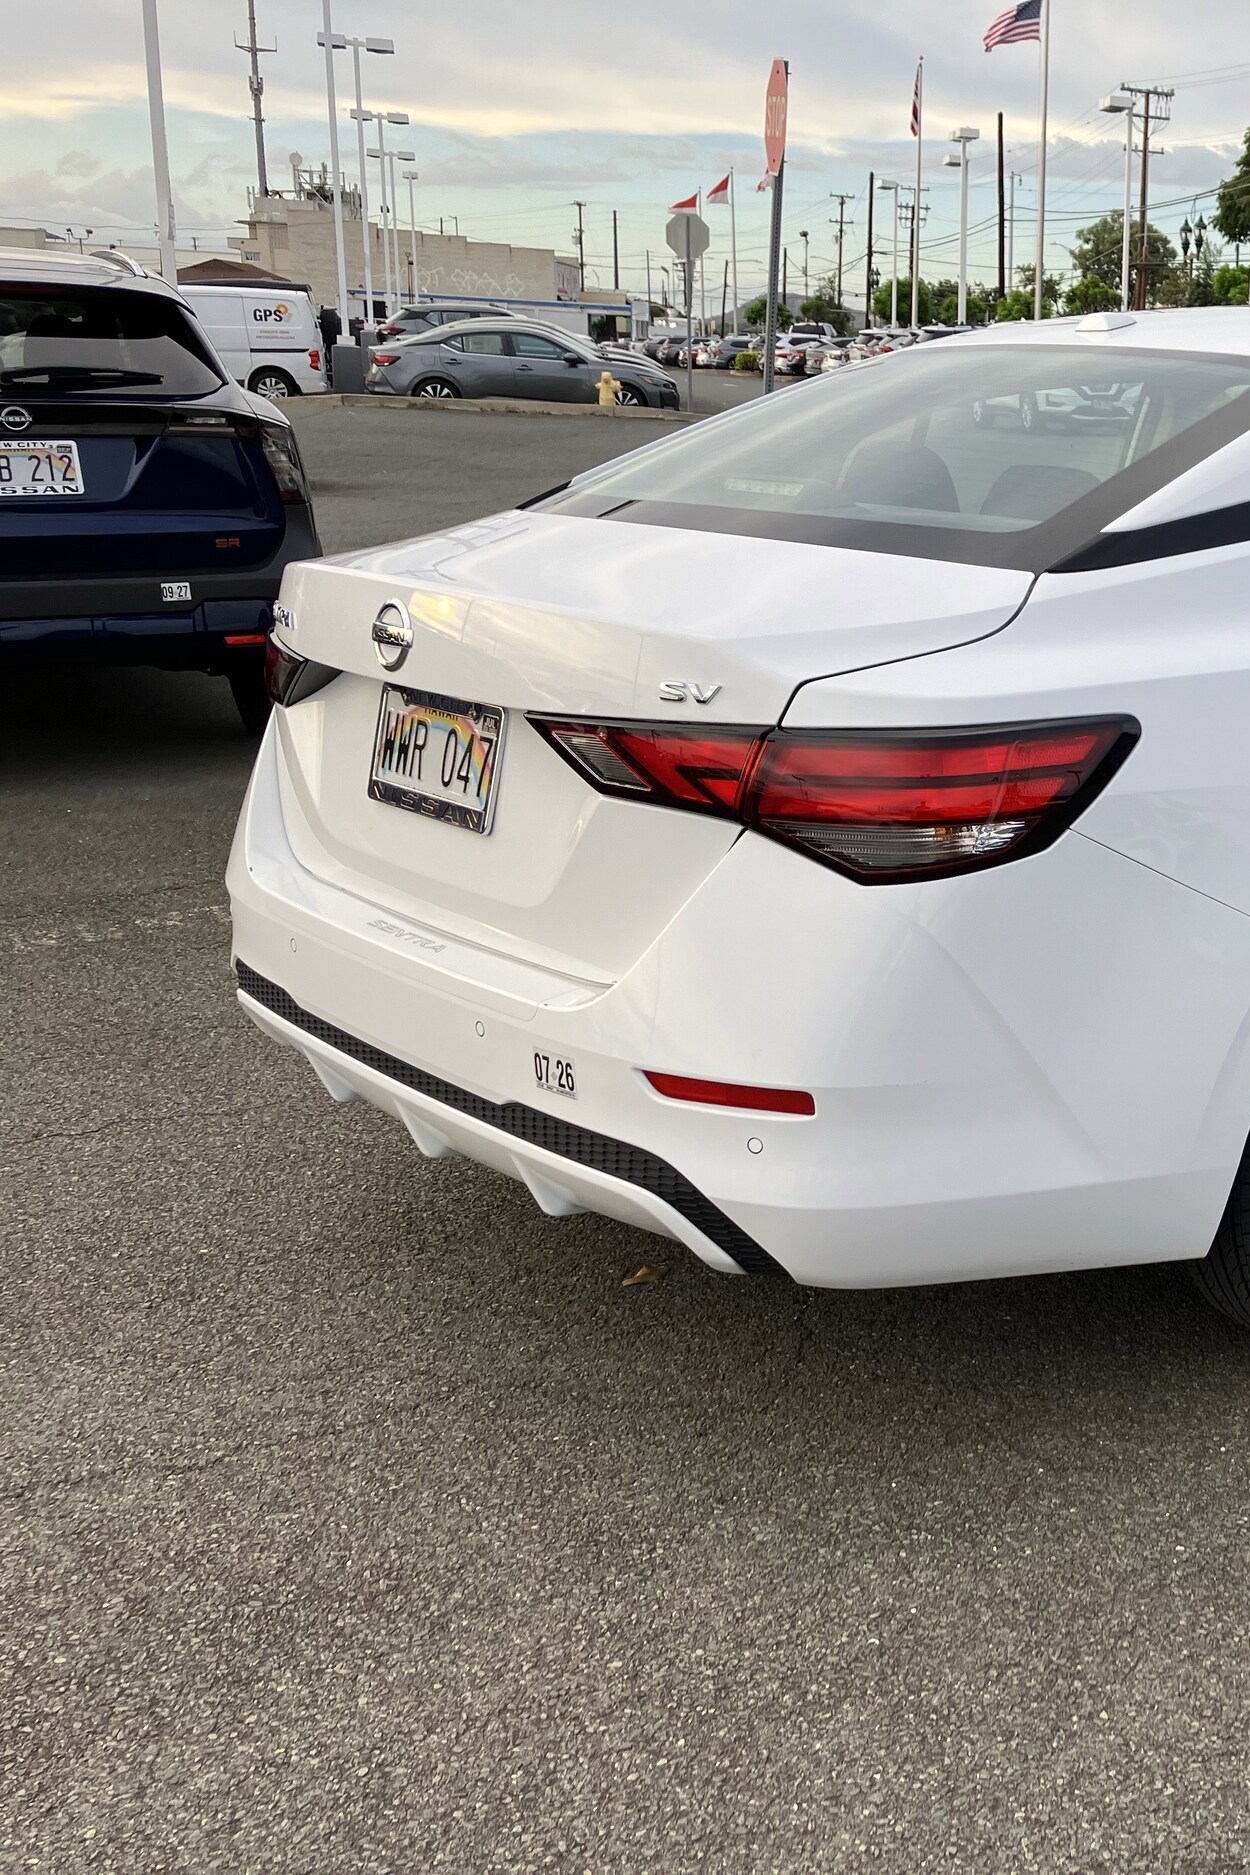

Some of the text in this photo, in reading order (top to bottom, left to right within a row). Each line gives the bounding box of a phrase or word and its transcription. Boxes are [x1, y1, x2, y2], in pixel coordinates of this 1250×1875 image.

[766, 95, 786, 137] STOP
[253, 308, 283, 322] GPS
[28, 454, 75, 482] 212
[215, 538, 240, 548] SR
[162, 585, 188, 598] 09 27
[659, 680, 722, 705] SV
[484, 717, 496, 729] JUL
[381, 709, 494, 798] WWR 047
[373, 780, 479, 830] NISSAN
[366, 919, 447, 953] SENTRA
[534, 1052, 550, 1084] 07
[556, 1059, 575, 1092] 26
